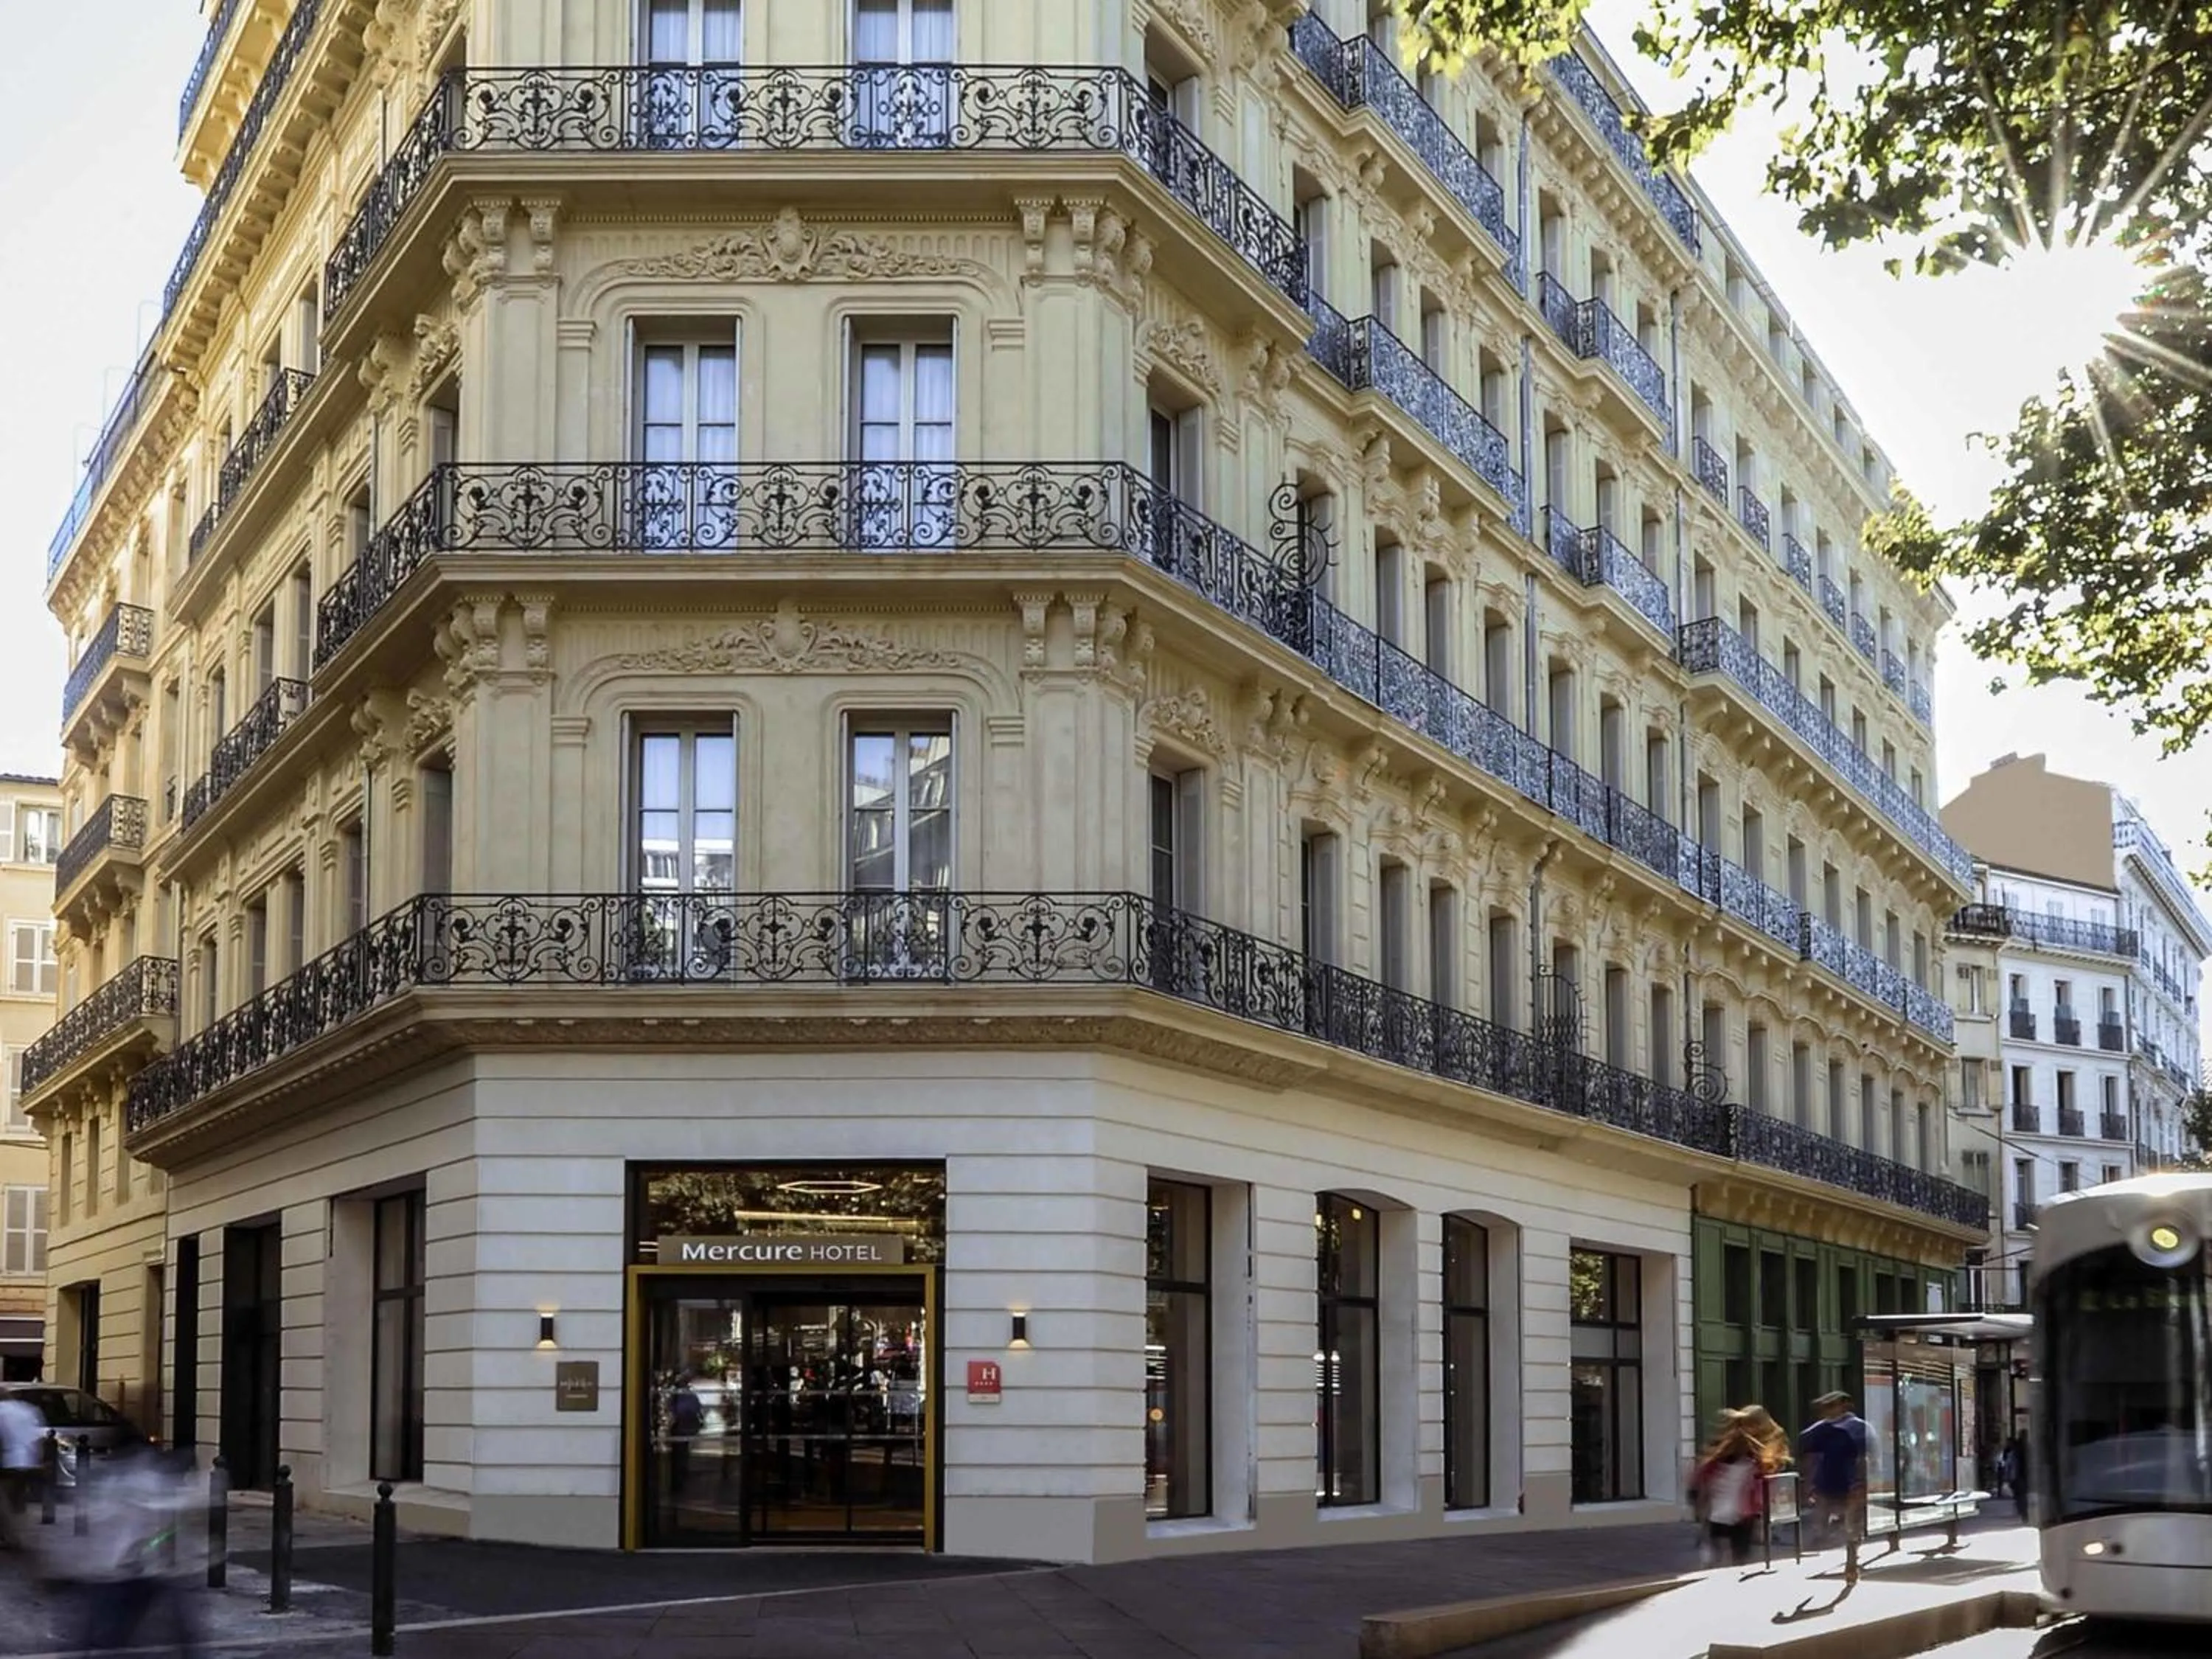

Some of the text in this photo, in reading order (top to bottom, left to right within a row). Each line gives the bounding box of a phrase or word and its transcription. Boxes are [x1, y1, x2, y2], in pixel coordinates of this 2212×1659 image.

[682, 1242, 882, 1260] Mercure HOTEL
[982, 1367, 995, 1380] H
